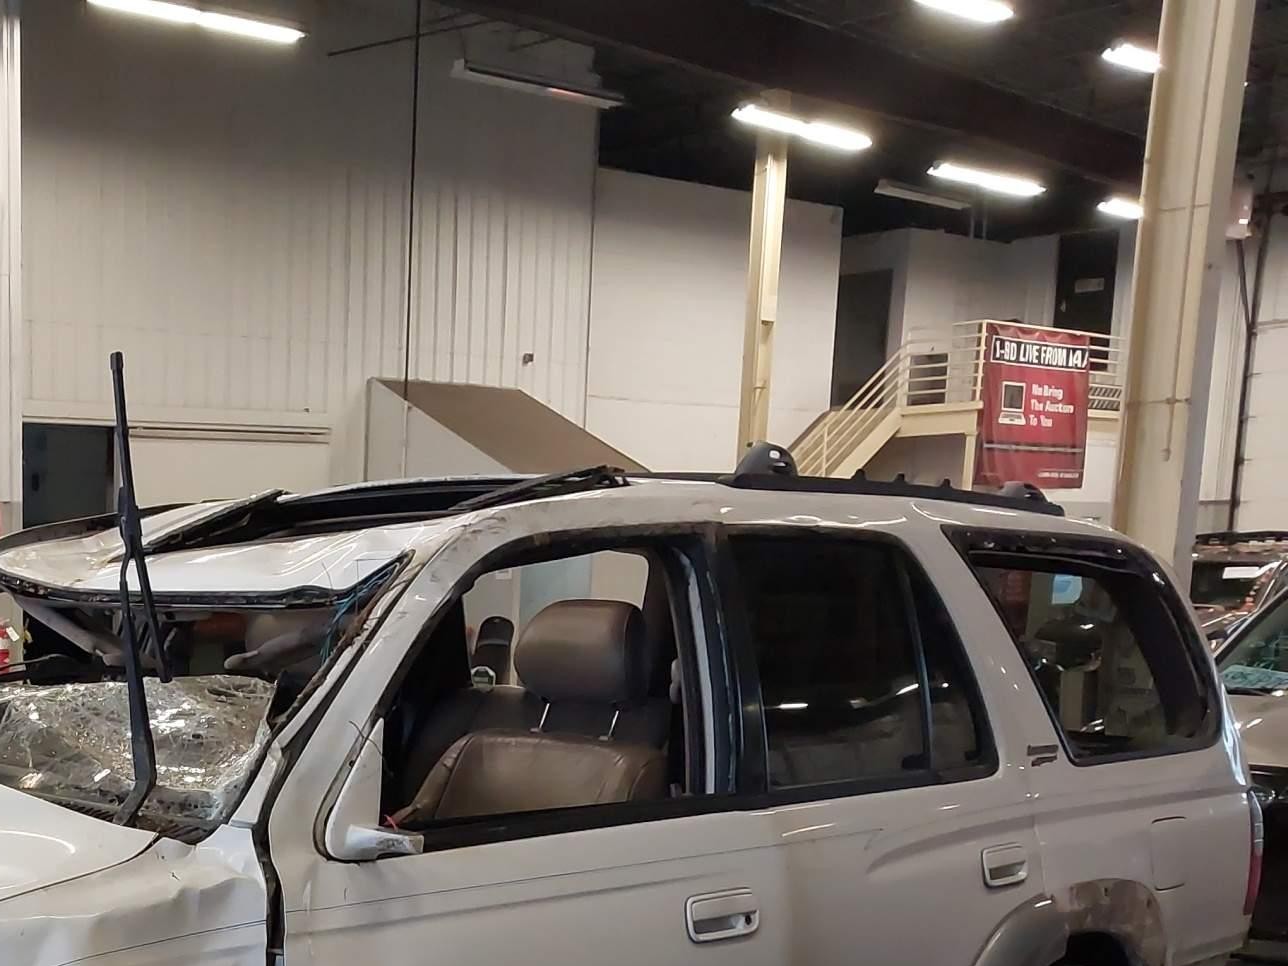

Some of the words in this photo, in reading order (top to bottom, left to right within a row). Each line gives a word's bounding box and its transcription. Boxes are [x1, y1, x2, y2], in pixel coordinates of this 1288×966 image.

[1019, 343, 1040, 364] LIVE
[1040, 346, 1067, 367] FROM
[1043, 384, 1063, 400] Bring
[1031, 399, 1043, 411] The
[1029, 414, 1038, 426] To
[1040, 415, 1053, 427] You
